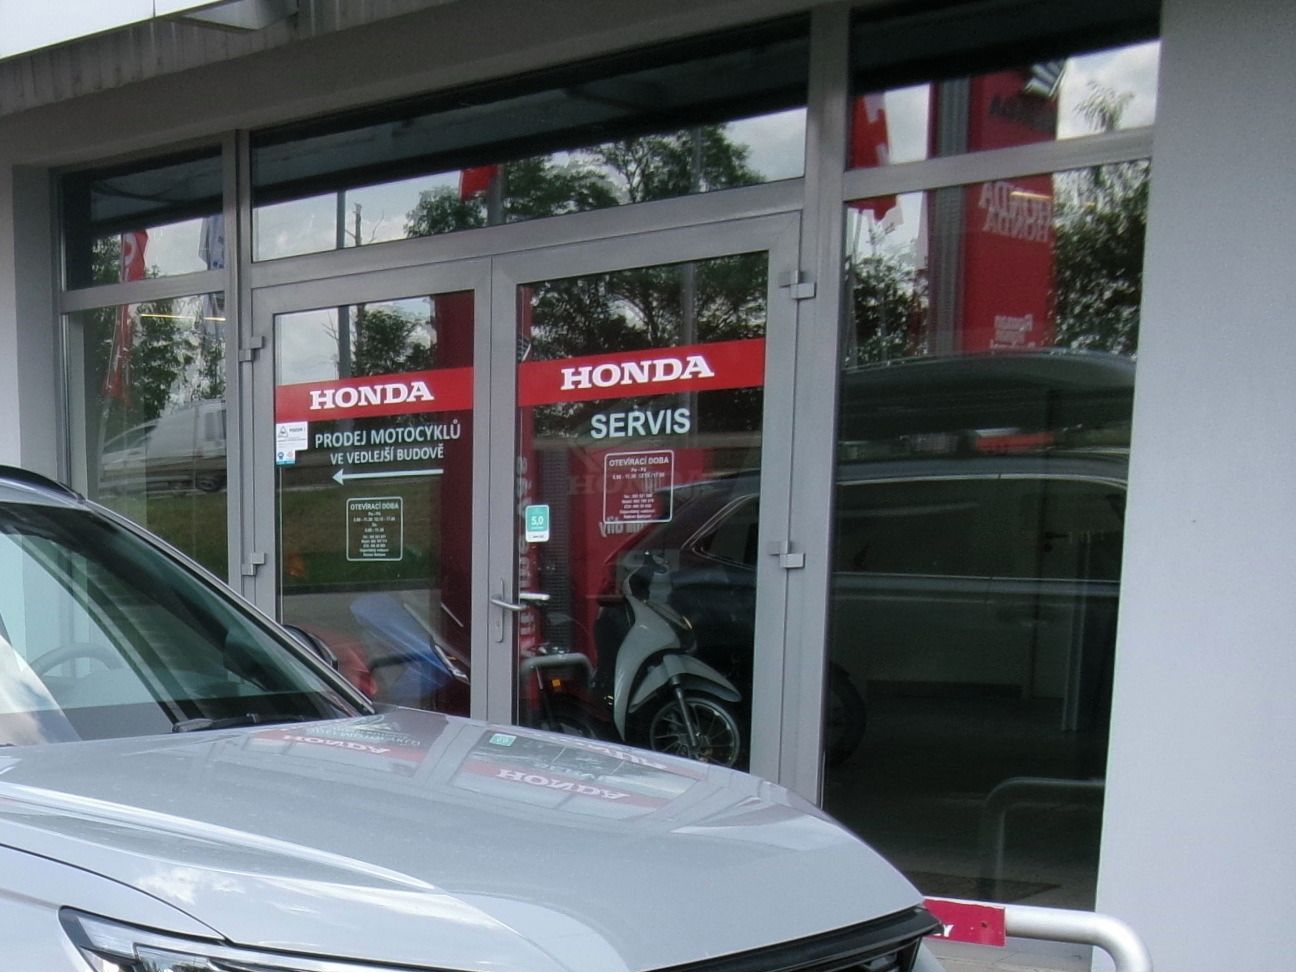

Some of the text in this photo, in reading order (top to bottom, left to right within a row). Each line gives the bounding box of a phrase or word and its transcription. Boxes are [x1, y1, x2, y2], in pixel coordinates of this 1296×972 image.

[560, 355, 715, 390] HONDA
[309, 381, 435, 410] HONDA
[315, 431, 366, 448] PRODEJ
[370, 419, 461, 445] MOTOCYKLŮ
[590, 408, 691, 439] SERVIS
[330, 443, 444, 465] VE VEDLEJŠÍ BUDOVĚ
[648, 456, 669, 464] DOBA
